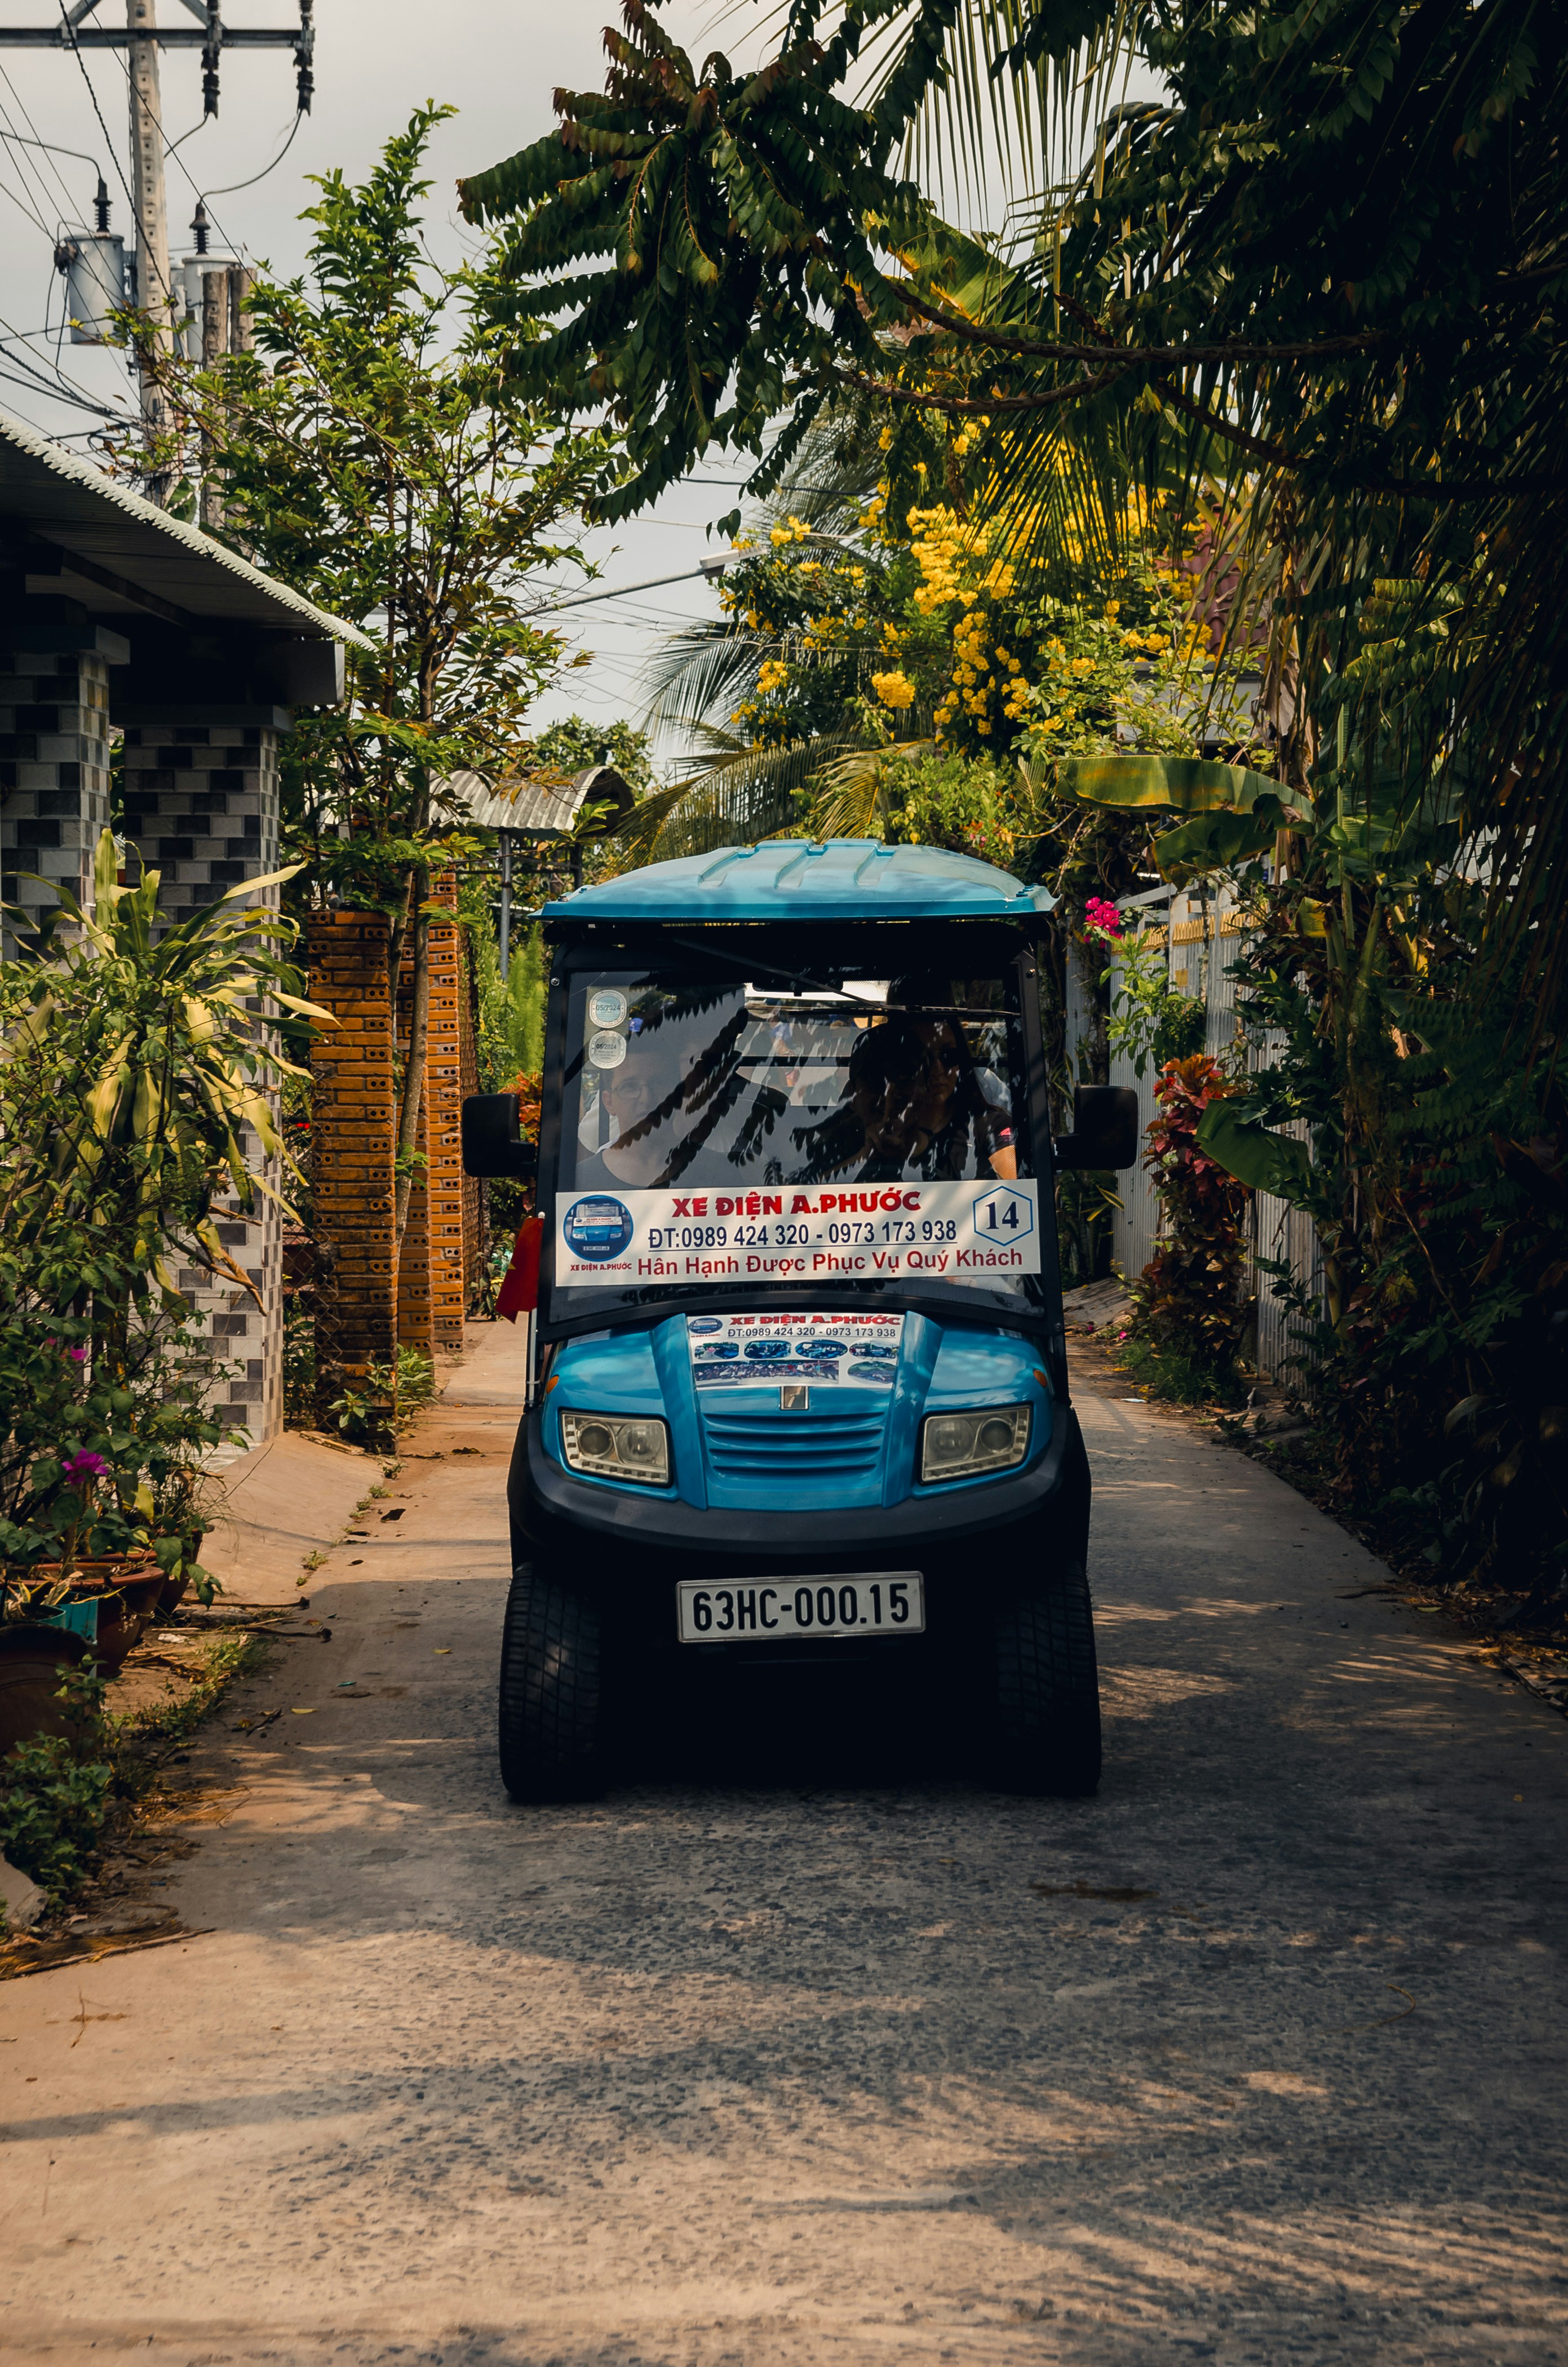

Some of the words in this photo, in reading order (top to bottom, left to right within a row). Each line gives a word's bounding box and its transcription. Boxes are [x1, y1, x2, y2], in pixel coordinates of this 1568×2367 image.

[671, 1197, 708, 1217] XE
[715, 1191, 782, 1220] ĐIỆN
[790, 1187, 921, 1214] A.PHƯỚC
[986, 1201, 1020, 1230] 14
[649, 1226, 727, 1248] ĐT:0989
[734, 1226, 768, 1245] 424
[776, 1225, 808, 1245] 320
[829, 1222, 874, 1243] 0973
[882, 1222, 915, 1242] 173
[922, 1220, 956, 1240] 938
[600, 1262, 632, 1270] A.PHƯỚC
[639, 1258, 677, 1275] Hân
[685, 1256, 739, 1278] Hạnh
[746, 1255, 805, 1276] Được
[813, 1253, 866, 1274] Phục
[871, 1251, 900, 1273] Vụ
[906, 1250, 949, 1272] Quý
[956, 1248, 1022, 1266] Khách
[730, 1317, 755, 1325] XE
[759, 1314, 806, 1326] ĐIỆN
[811, 1315, 901, 1325] A.PHƯỚC
[693, 1583, 909, 1632] 63HC-000.15
